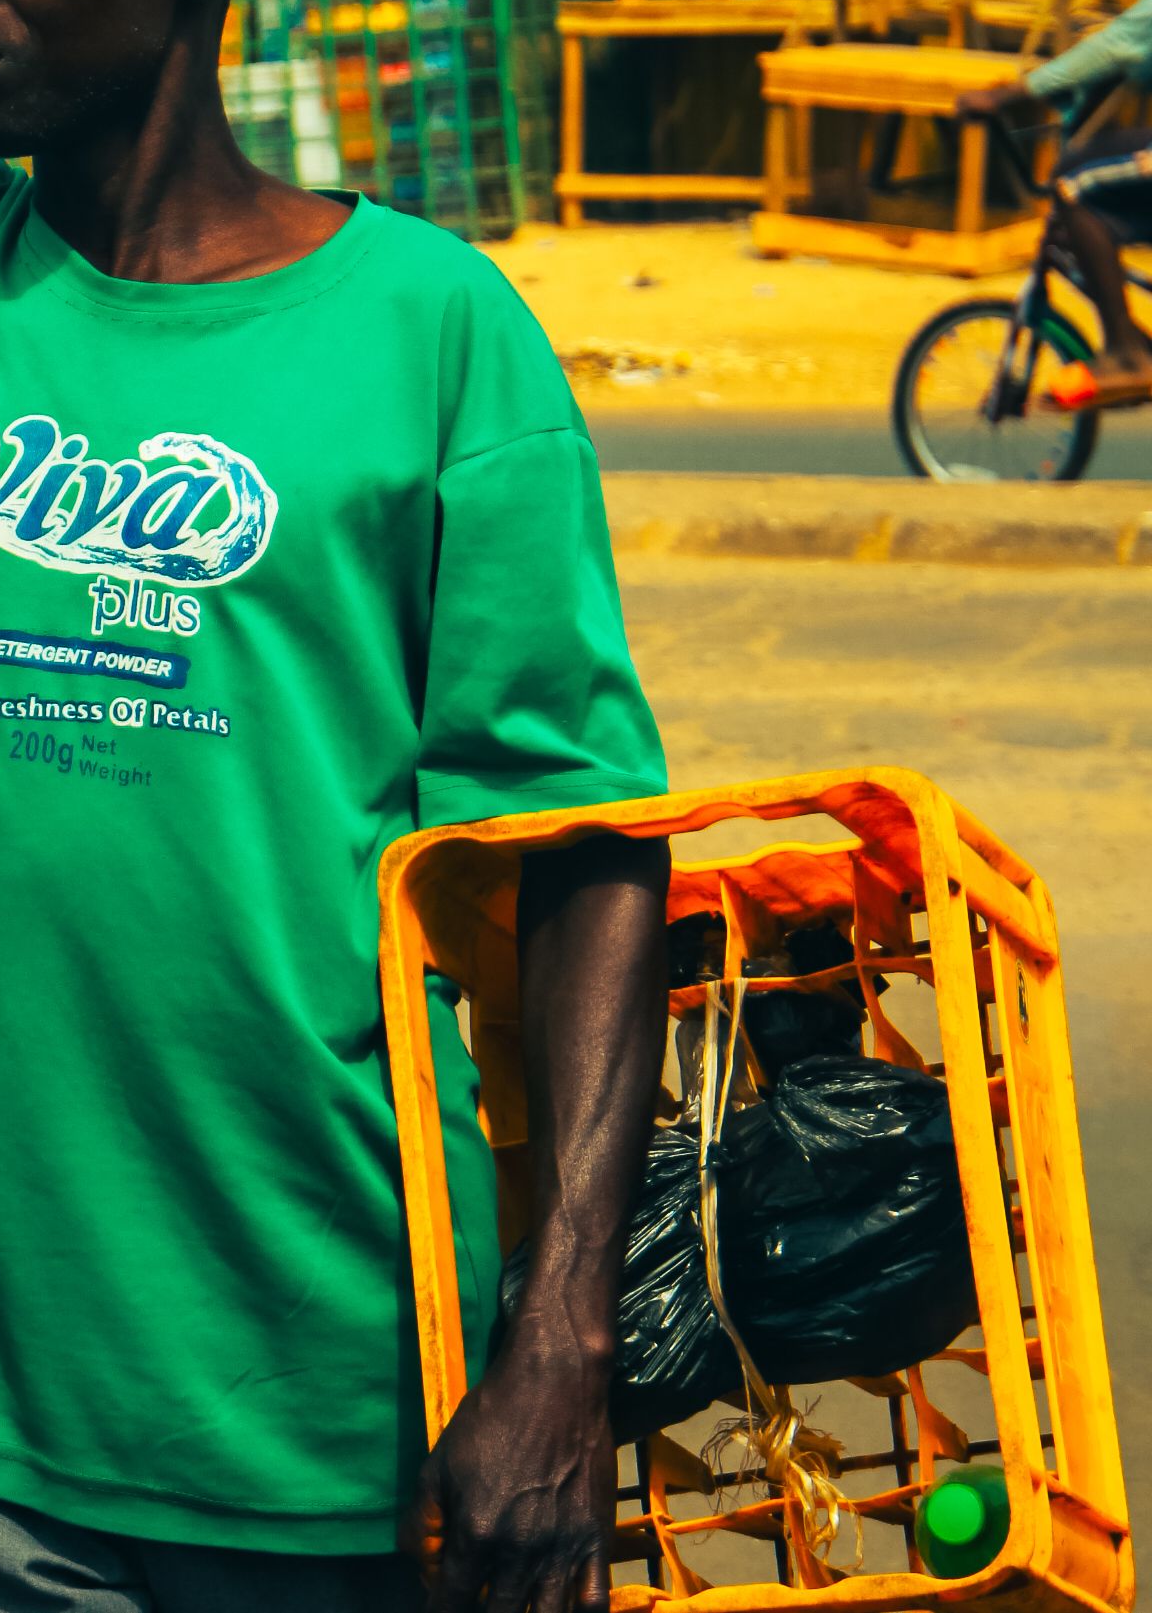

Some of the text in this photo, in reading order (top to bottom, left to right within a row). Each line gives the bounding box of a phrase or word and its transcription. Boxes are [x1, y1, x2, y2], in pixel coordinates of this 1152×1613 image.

[89, 575, 200, 636] plus
[93, 651, 173, 678] POWDER
[109, 696, 146, 726] Of
[152, 701, 231, 736] Petals
[10, 729, 117, 773] 200g Net
[79, 762, 152, 786] Weight
